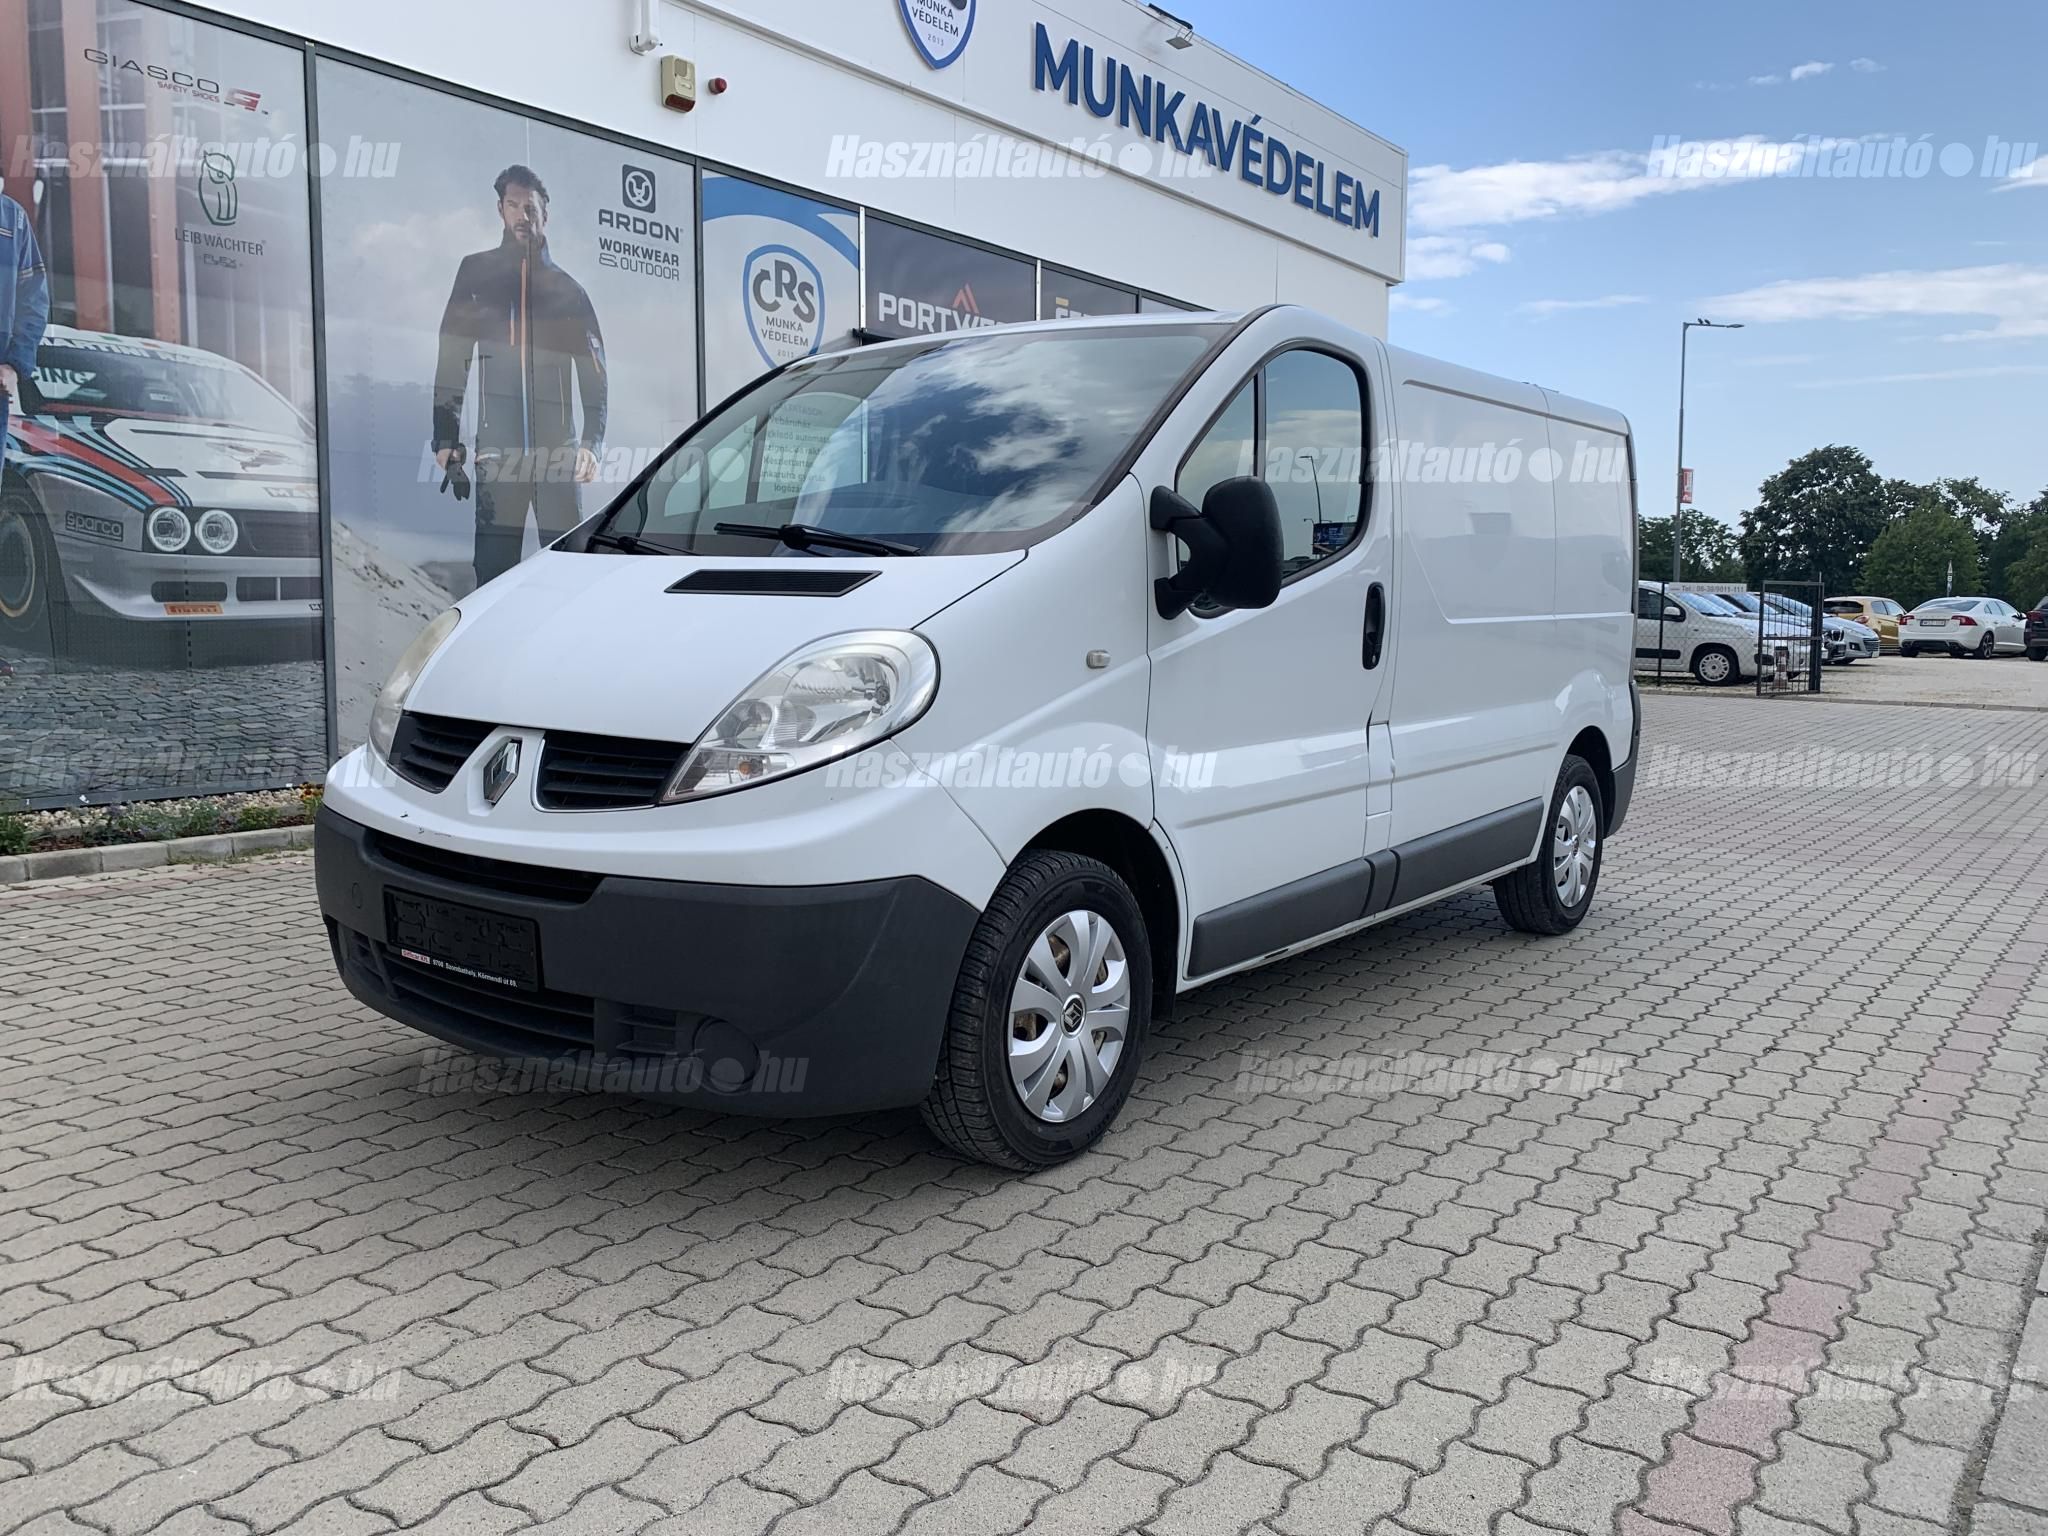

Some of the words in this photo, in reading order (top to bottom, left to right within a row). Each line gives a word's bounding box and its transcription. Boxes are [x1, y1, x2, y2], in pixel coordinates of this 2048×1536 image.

[911, 6, 959, 37] VÉDELEM
[84, 48, 220, 94] GIASCO
[157, 80, 187, 95] SAFETY
[192, 90, 220, 103] SHOES
[1034, 22, 1380, 239] MUNKAVÉDELEM
[599, 208, 680, 244] ARDON
[599, 236, 679, 267] WORKWEAR
[752, 259, 816, 323] CRS
[766, 315, 803, 332] MUNKA
[878, 291, 1010, 334] PORTW
[761, 327, 809, 347] VÉDELEM
[66, 512, 121, 536] sparco
